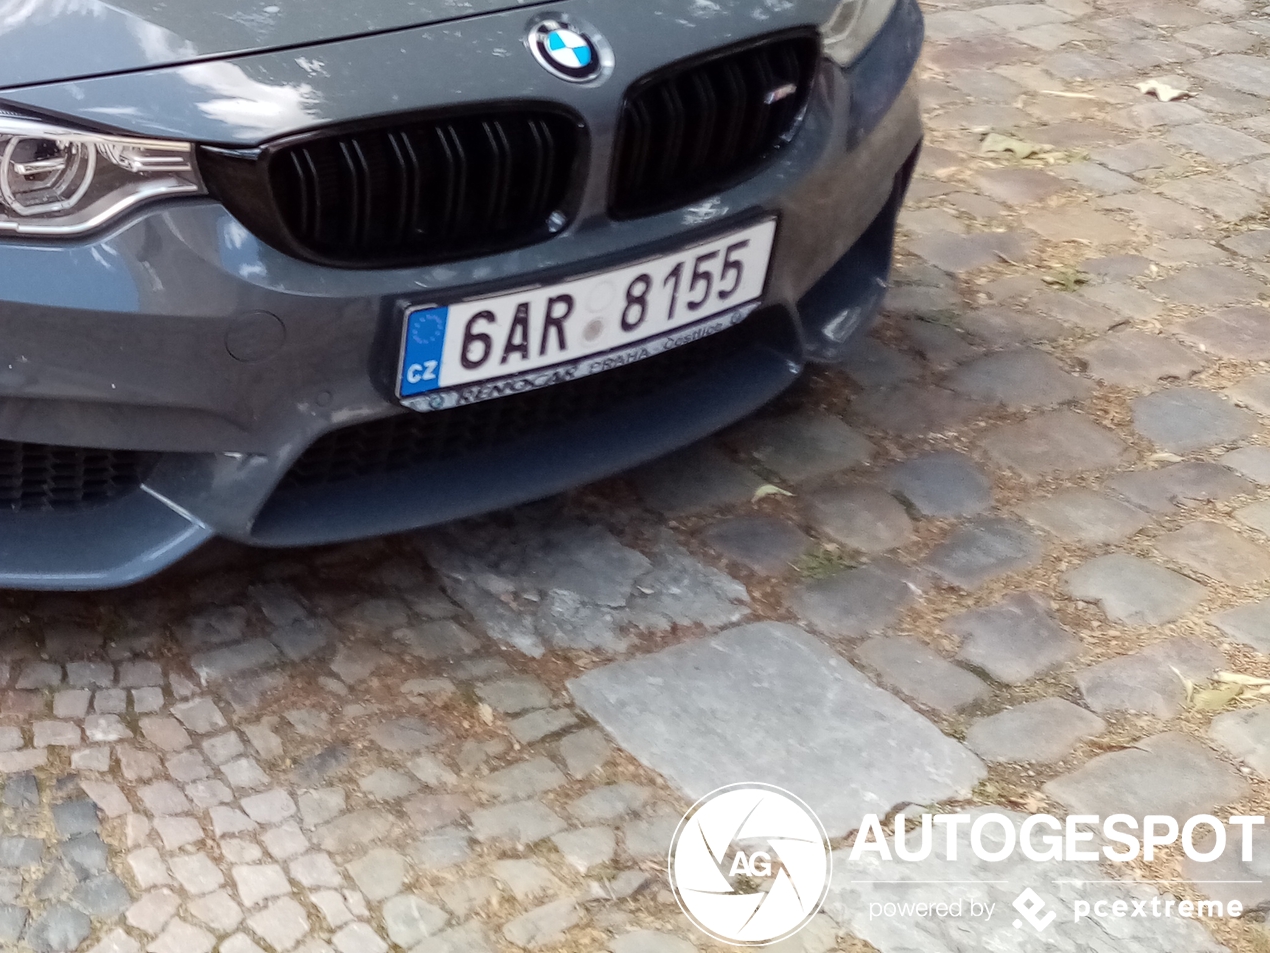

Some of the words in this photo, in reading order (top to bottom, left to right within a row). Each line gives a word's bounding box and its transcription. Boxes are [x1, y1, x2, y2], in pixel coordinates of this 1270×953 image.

[459, 293, 575, 371] 6AR
[619, 238, 751, 334] 8155
[406, 359, 439, 384] CZ
[589, 347, 652, 374] PRAHA
